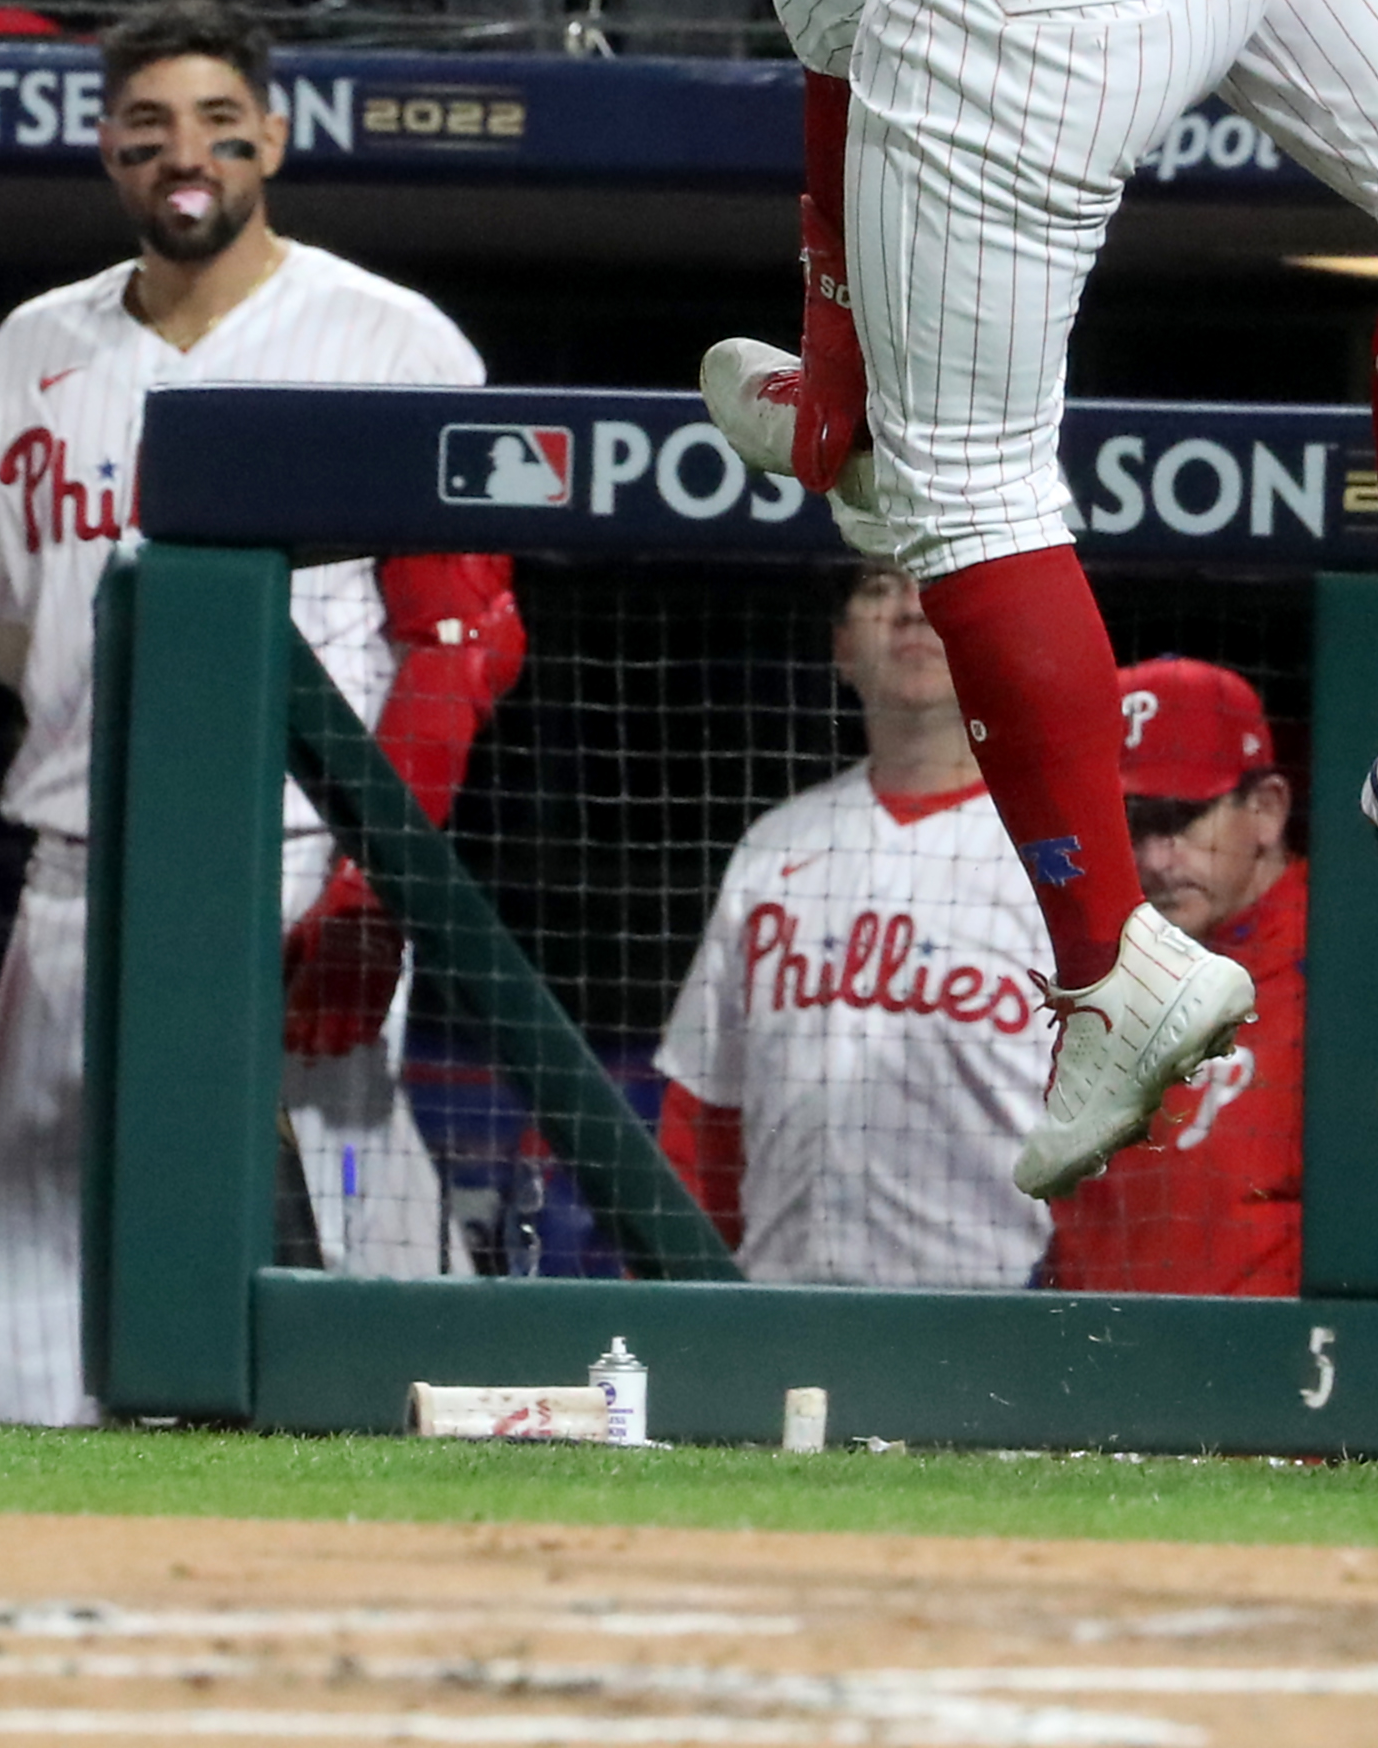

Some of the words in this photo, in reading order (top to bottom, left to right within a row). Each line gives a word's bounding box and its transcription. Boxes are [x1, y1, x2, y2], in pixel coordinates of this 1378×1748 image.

[362, 97, 524, 137] 2022
[1121, 690, 1159, 748] P
[743, 902, 1030, 1034] Phillies
